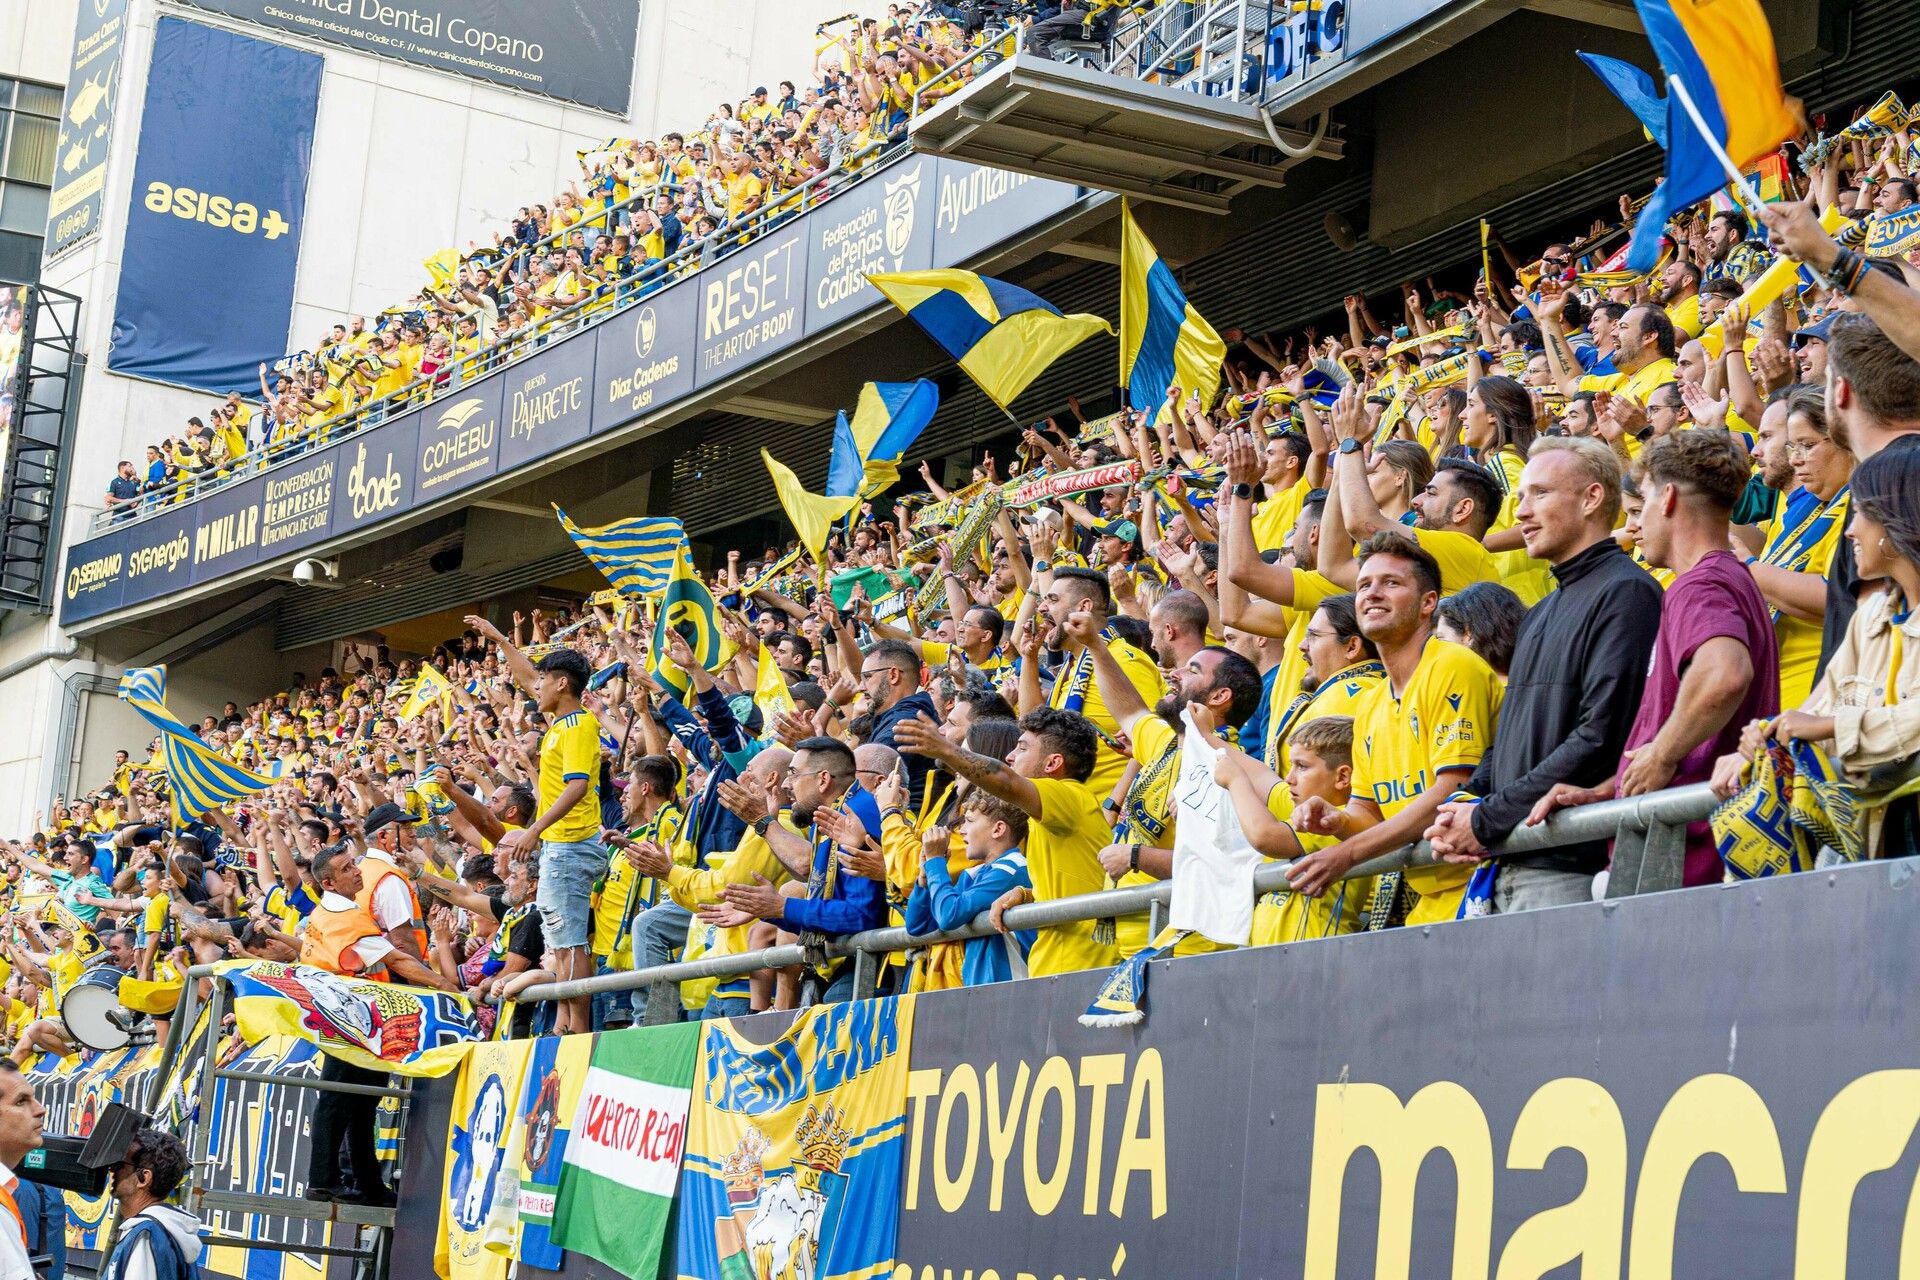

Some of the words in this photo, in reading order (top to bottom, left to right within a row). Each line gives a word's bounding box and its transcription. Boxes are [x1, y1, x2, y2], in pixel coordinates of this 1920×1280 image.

[295, 14, 324, 28] dental
[324, 22, 350, 35] oficial
[350, 29, 365, 39] del
[391, 38, 406, 49] C.F.
[416, 45, 543, 82] www.clinicadentalcopano.com
[360, 0, 441, 38] Dental
[447, 18, 544, 63] Copano
[144, 181, 259, 234] asisa
[822, 206, 877, 251] Federación
[828, 252, 841, 276] de
[841, 229, 883, 270] Peñas
[704, 237, 799, 341] RESET
[817, 255, 885, 310] Cadistas
[704, 342, 722, 370] THE
[723, 332, 745, 362] ART
[745, 325, 760, 351] OF
[761, 307, 795, 343] BODY
[633, 355, 679, 391] Cadenas
[632, 389, 652, 411] CASH
[422, 420, 494, 473] COHEBU
[272, 483, 331, 522] EMPRESAS
[273, 460, 334, 500] CONFEDERACIÓN
[208, 504, 259, 560] MILAR
[300, 519, 309, 534] DE
[79, 553, 122, 585] SERRANO
[905, 1047, 1168, 1221] TOYOTA
[1303, 1068, 1920, 1280] macr
